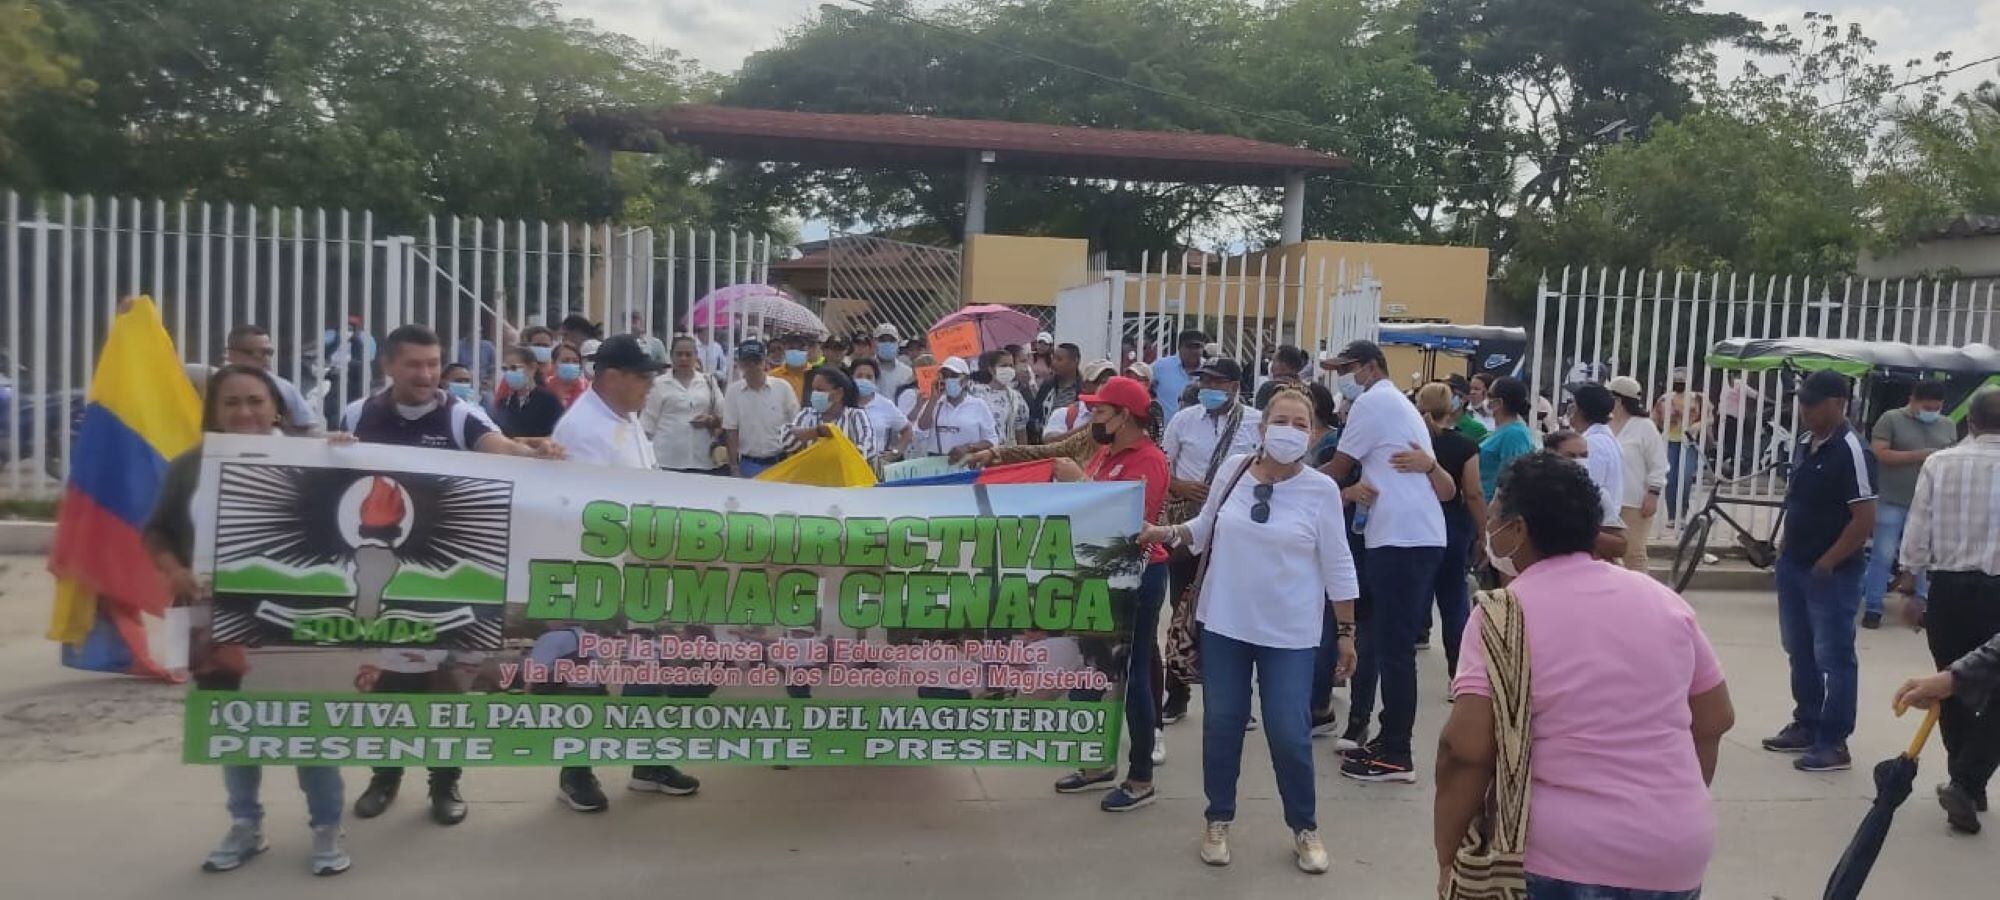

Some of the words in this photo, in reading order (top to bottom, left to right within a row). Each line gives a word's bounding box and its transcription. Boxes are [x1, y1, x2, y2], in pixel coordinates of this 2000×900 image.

[581, 499, 1076, 570] SUBDIRECTIVA
[527, 559, 821, 626] EDUMAG
[839, 559, 1115, 632] CIÉNAGA
[292, 616, 438, 643] EDUMAG
[578, 633, 627, 658] Por
[631, 634, 653, 660] la
[661, 634, 762, 661] Defensa
[770, 637, 800, 662] de
[807, 639, 826, 662] la
[834, 638, 961, 663] Educación
[964, 639, 1048, 664] Pública
[500, 662, 518, 688] y
[524, 658, 548, 683] la
[554, 659, 742, 686] Reivindicación
[750, 665, 780, 686] de
[786, 666, 821, 686] los
[829, 664, 940, 688] Derechos
[946, 666, 982, 688] del
[209, 700, 311, 731] ¡QUE
[324, 702, 416, 728] VIVA
[429, 703, 475, 728] EL
[487, 703, 593, 729] PARO
[604, 704, 791, 730] NACIONAL
[802, 706, 868, 731] DEL
[878, 706, 1105, 734] MAGISTERIO!
[208, 735, 494, 760] PRESENTE
[553, 737, 812, 760] PRESENTE
[865, 738, 1104, 761] PRESENTE
